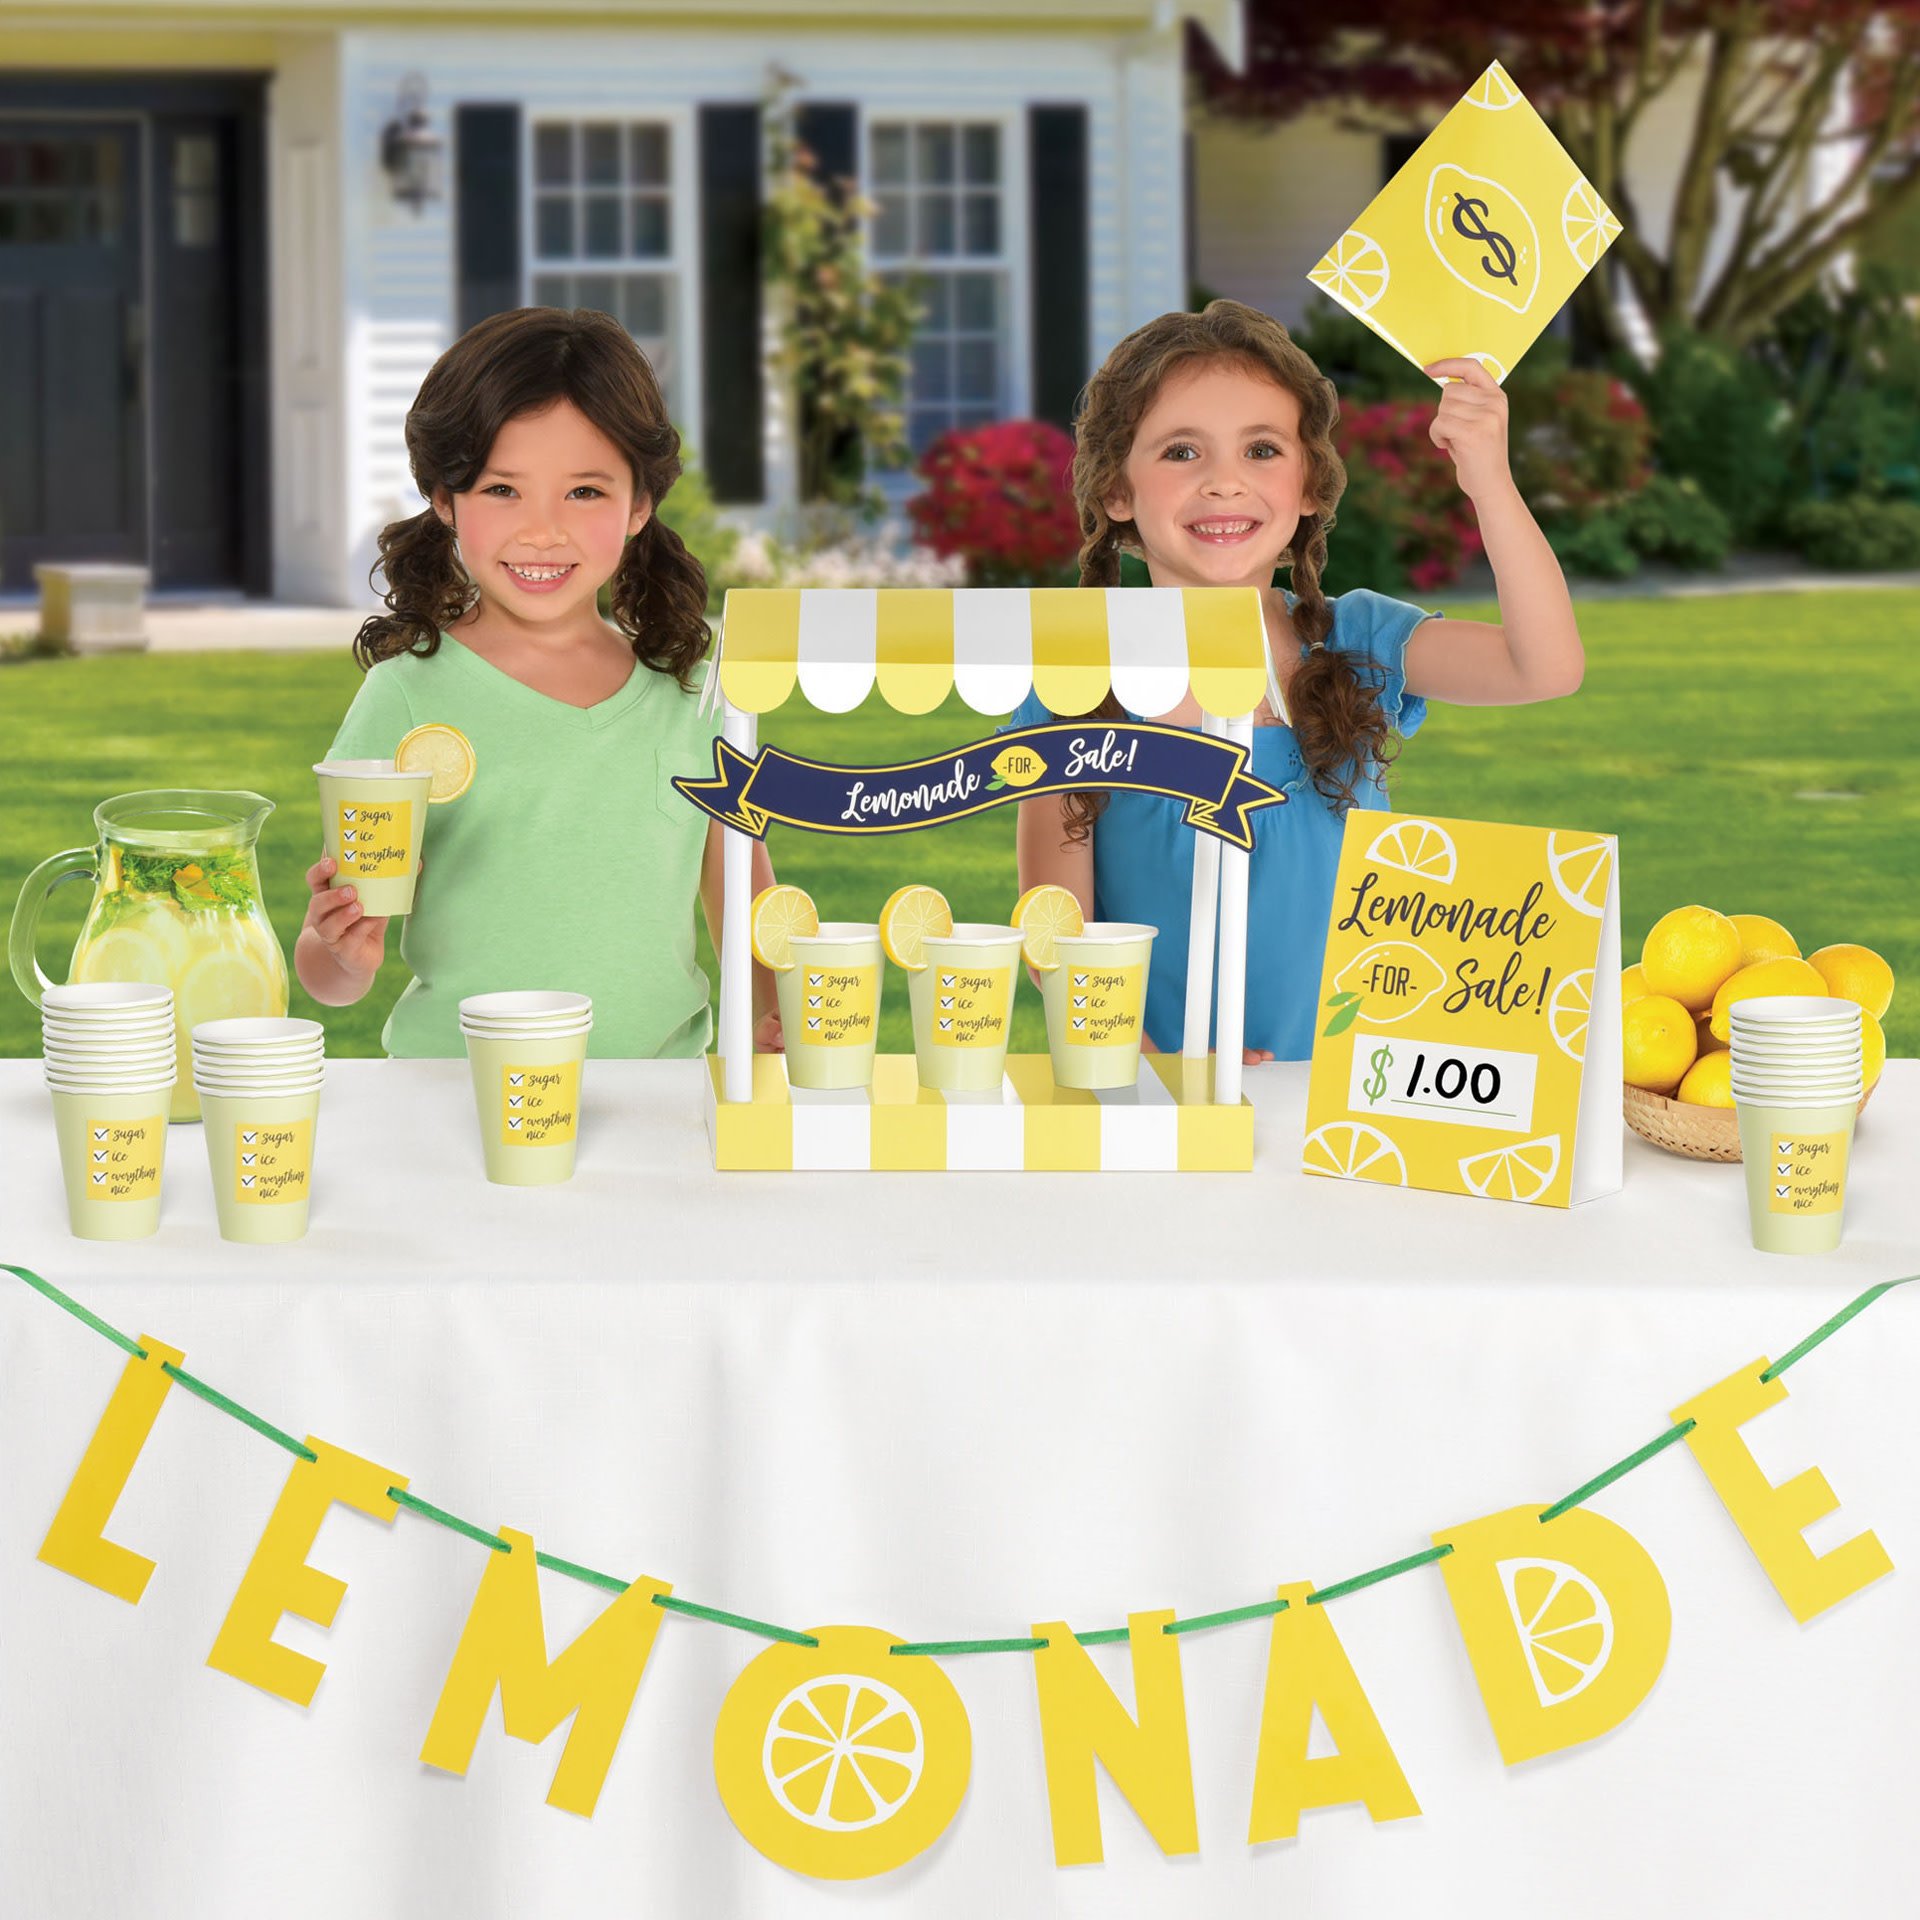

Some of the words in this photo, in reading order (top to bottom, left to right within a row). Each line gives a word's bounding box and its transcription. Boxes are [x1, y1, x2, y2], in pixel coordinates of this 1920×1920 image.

[1454, 192, 1518, 286] $
[840, 759, 981, 822] Lemonade
[1064, 730, 1138, 776] Sale!
[360, 809, 393, 826] sugar
[359, 830, 375, 841] ice
[359, 846, 405, 862] everything
[359, 863, 378, 872] nice
[1338, 872, 1557, 946] Lemonade
[827, 974, 861, 991] sugar
[959, 976, 993, 992] sugar
[1093, 974, 1126, 991] sugar
[1443, 951, 1552, 1015] Sale!
[826, 996, 842, 1008] ice
[958, 997, 974, 1009] ice
[1091, 996, 1106, 1008] ice
[825, 1015, 870, 1033] everything
[957, 1016, 1002, 1034] everything
[1090, 1014, 1136, 1032] everything
[824, 1031, 844, 1040] nice
[956, 1032, 975, 1042] nice
[1089, 1031, 1109, 1041] nice
[528, 1073, 562, 1091] sugar
[527, 1096, 543, 1107] ice
[526, 1110, 572, 1130] everything
[113, 1128, 146, 1147] sugar
[261, 1132, 295, 1148] sugar
[526, 1130, 545, 1141] nice
[111, 1151, 128, 1162] ice
[1797, 1143, 1831, 1159] sugar
[260, 1154, 277, 1166] ice
[111, 1165, 156, 1183] everything
[260, 1168, 304, 1187] everything
[1795, 1165, 1812, 1176] ice
[110, 1184, 131, 1195] nice
[259, 1187, 280, 1198] nice
[1794, 1180, 1839, 1199] everything
[1793, 1199, 1813, 1209] nice
[37, 1333, 1895, 1880] LEMONADE
